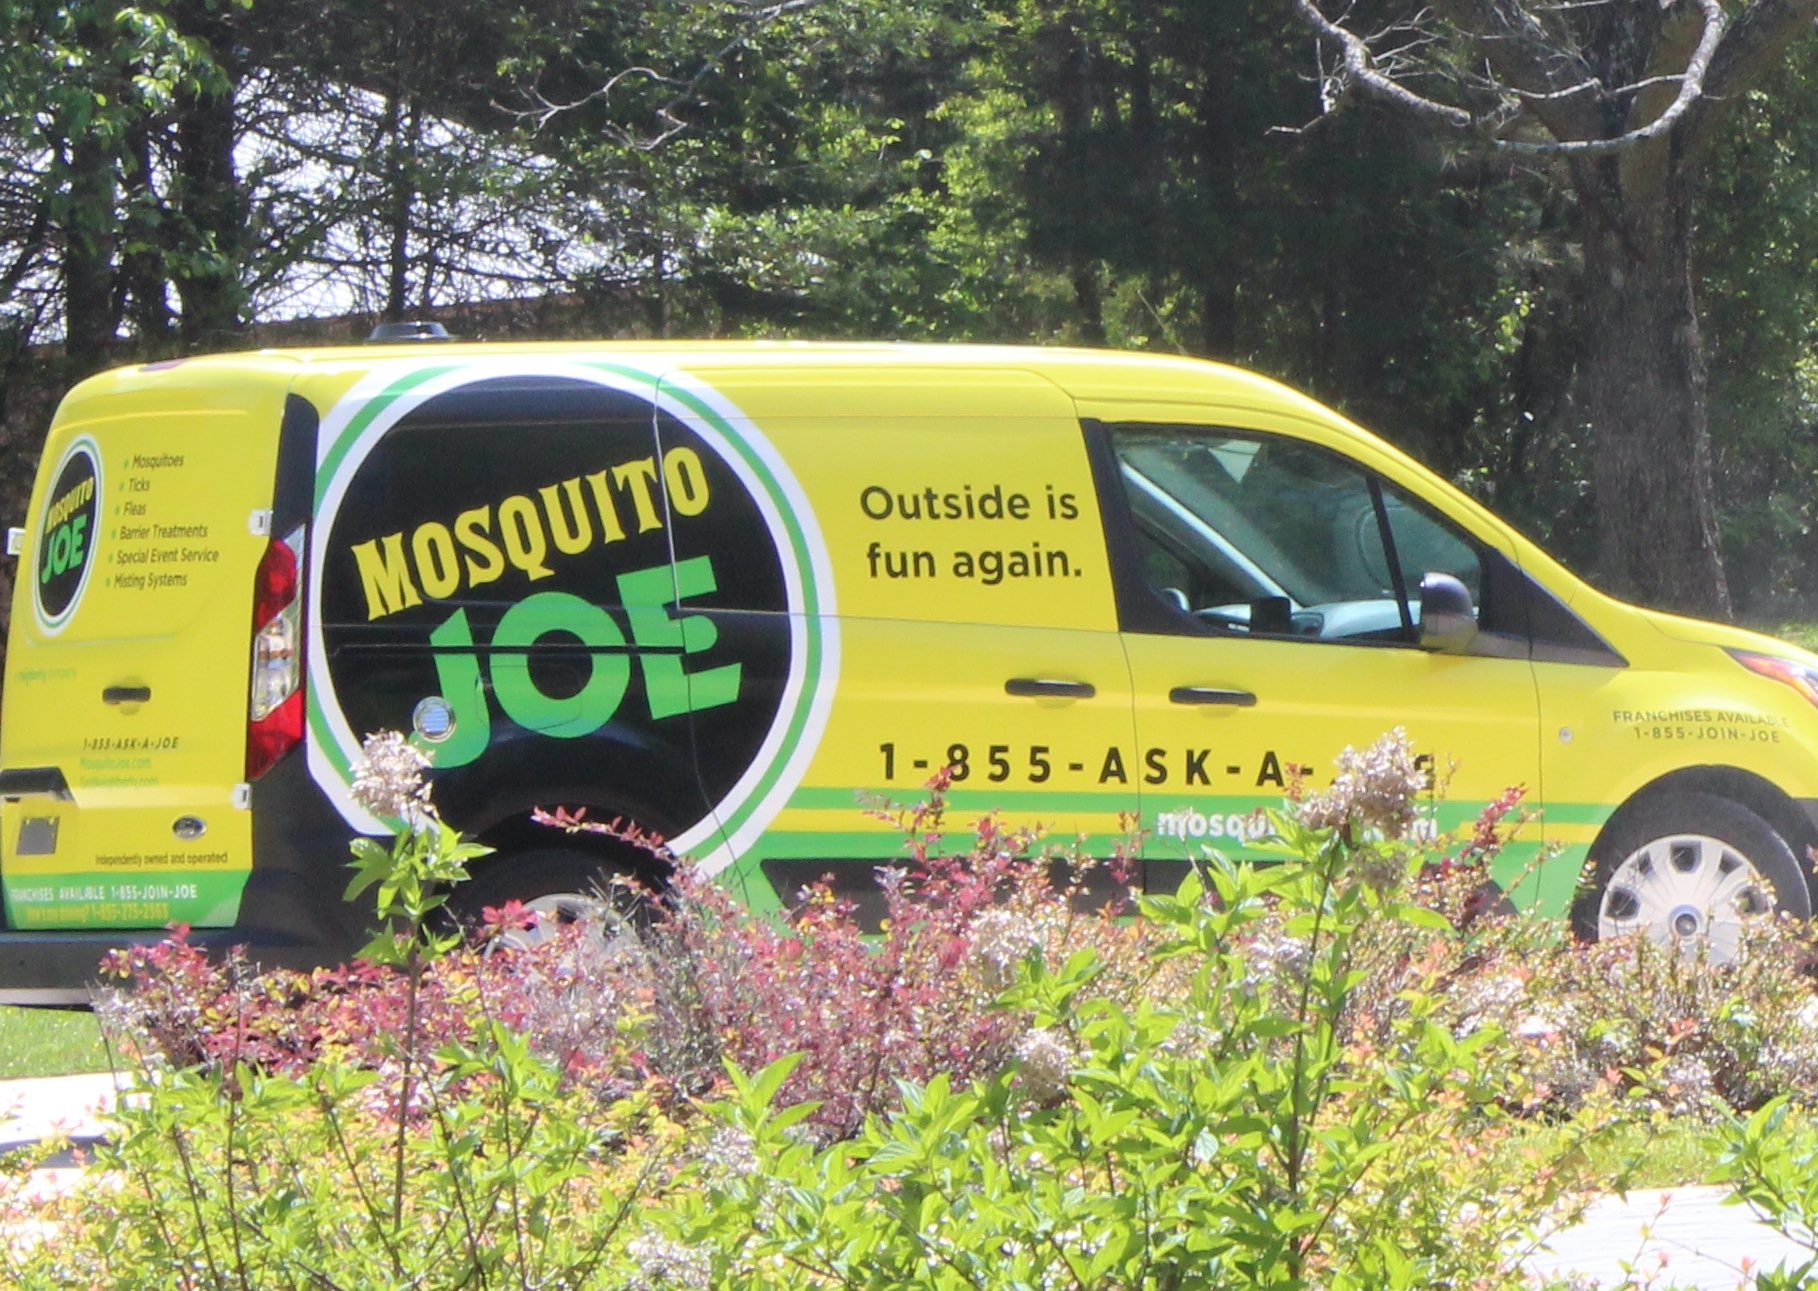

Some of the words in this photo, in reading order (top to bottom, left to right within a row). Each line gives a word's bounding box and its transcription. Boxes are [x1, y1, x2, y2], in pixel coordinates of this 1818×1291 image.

[132, 454, 184, 470] Mosquitoes
[129, 478, 150, 492] Ticks
[123, 502, 146, 516] Fleas
[860, 485, 1030, 520] Outside
[1046, 485, 1078, 520] is
[120, 526, 150, 540] Barrier
[152, 524, 208, 539] Treatments
[351, 447, 709, 621] MOSQUITO
[41, 514, 87, 584] JOE
[116, 549, 148, 565] Special
[150, 549, 178, 563] Event
[180, 547, 219, 562] Service
[867, 542, 936, 578] fun
[953, 542, 1082, 585] again.
[114, 574, 145, 590] Misting
[147, 572, 187, 588] Systems
[408, 555, 742, 769] JOE
[1613, 709, 1712, 723] FRANCHISES
[1716, 711, 1792, 729] AVAILABLE
[1634, 726, 1780, 743] 1-855-JOIN-JOE
[83, 737, 179, 750] 1-855-ASK-A-JOE
[170, 853, 185, 864] and
[187, 851, 228, 865] operated
[111, 884, 197, 900] 1-855-JOIN-JOE
